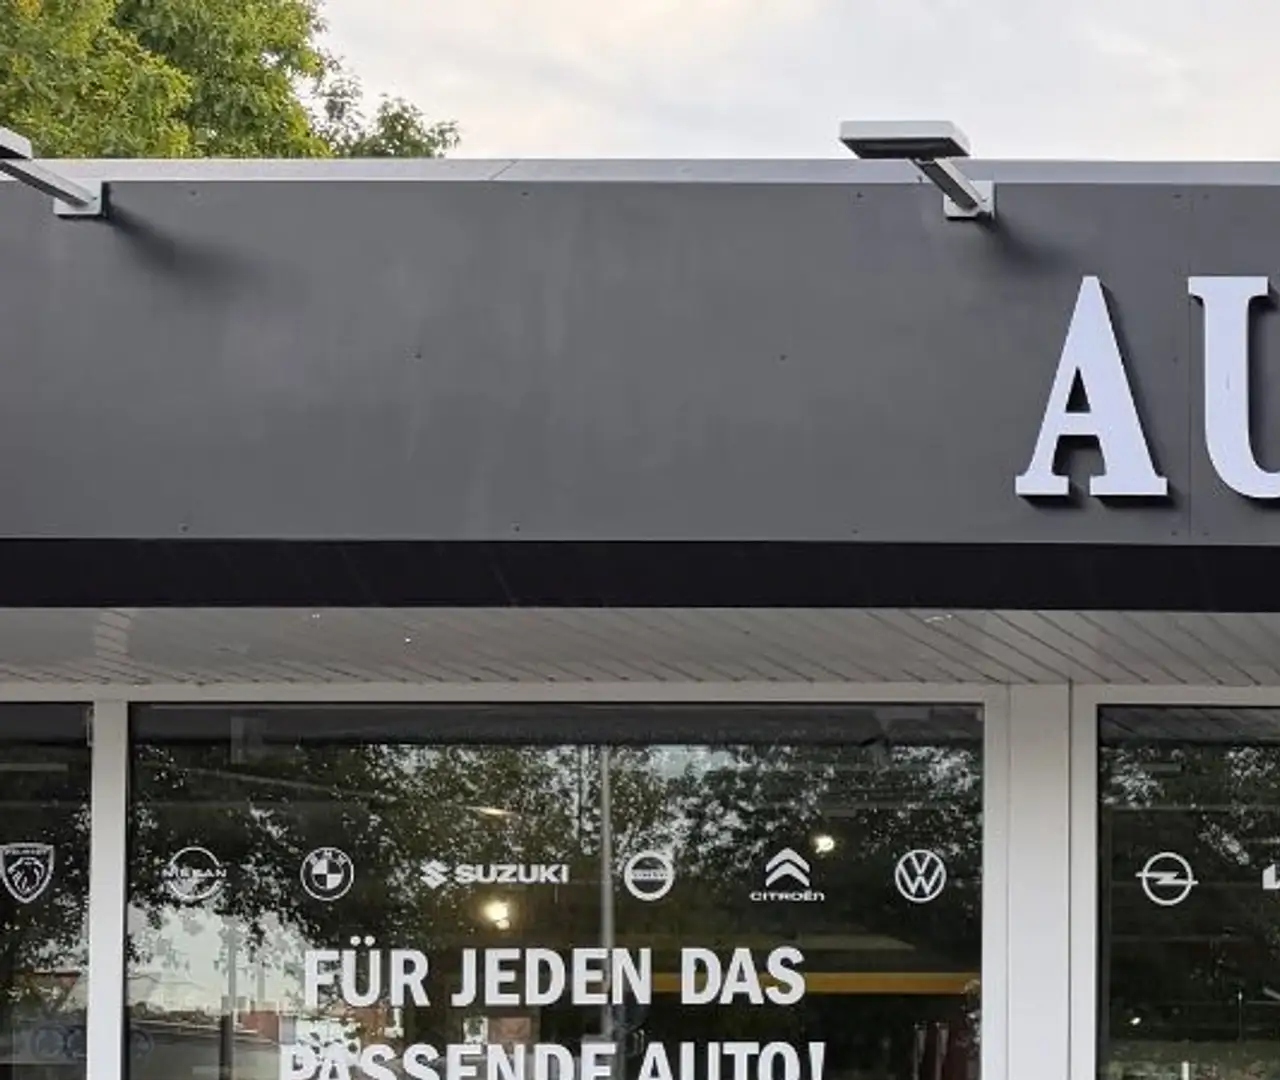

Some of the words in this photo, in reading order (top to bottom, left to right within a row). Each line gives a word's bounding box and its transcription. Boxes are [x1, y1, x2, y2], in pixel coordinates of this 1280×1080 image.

[454, 864, 569, 883] SUZUKI
[304, 936, 429, 1007] FÜR
[452, 948, 651, 1008] JEDEN
[681, 947, 805, 1007] DAS
